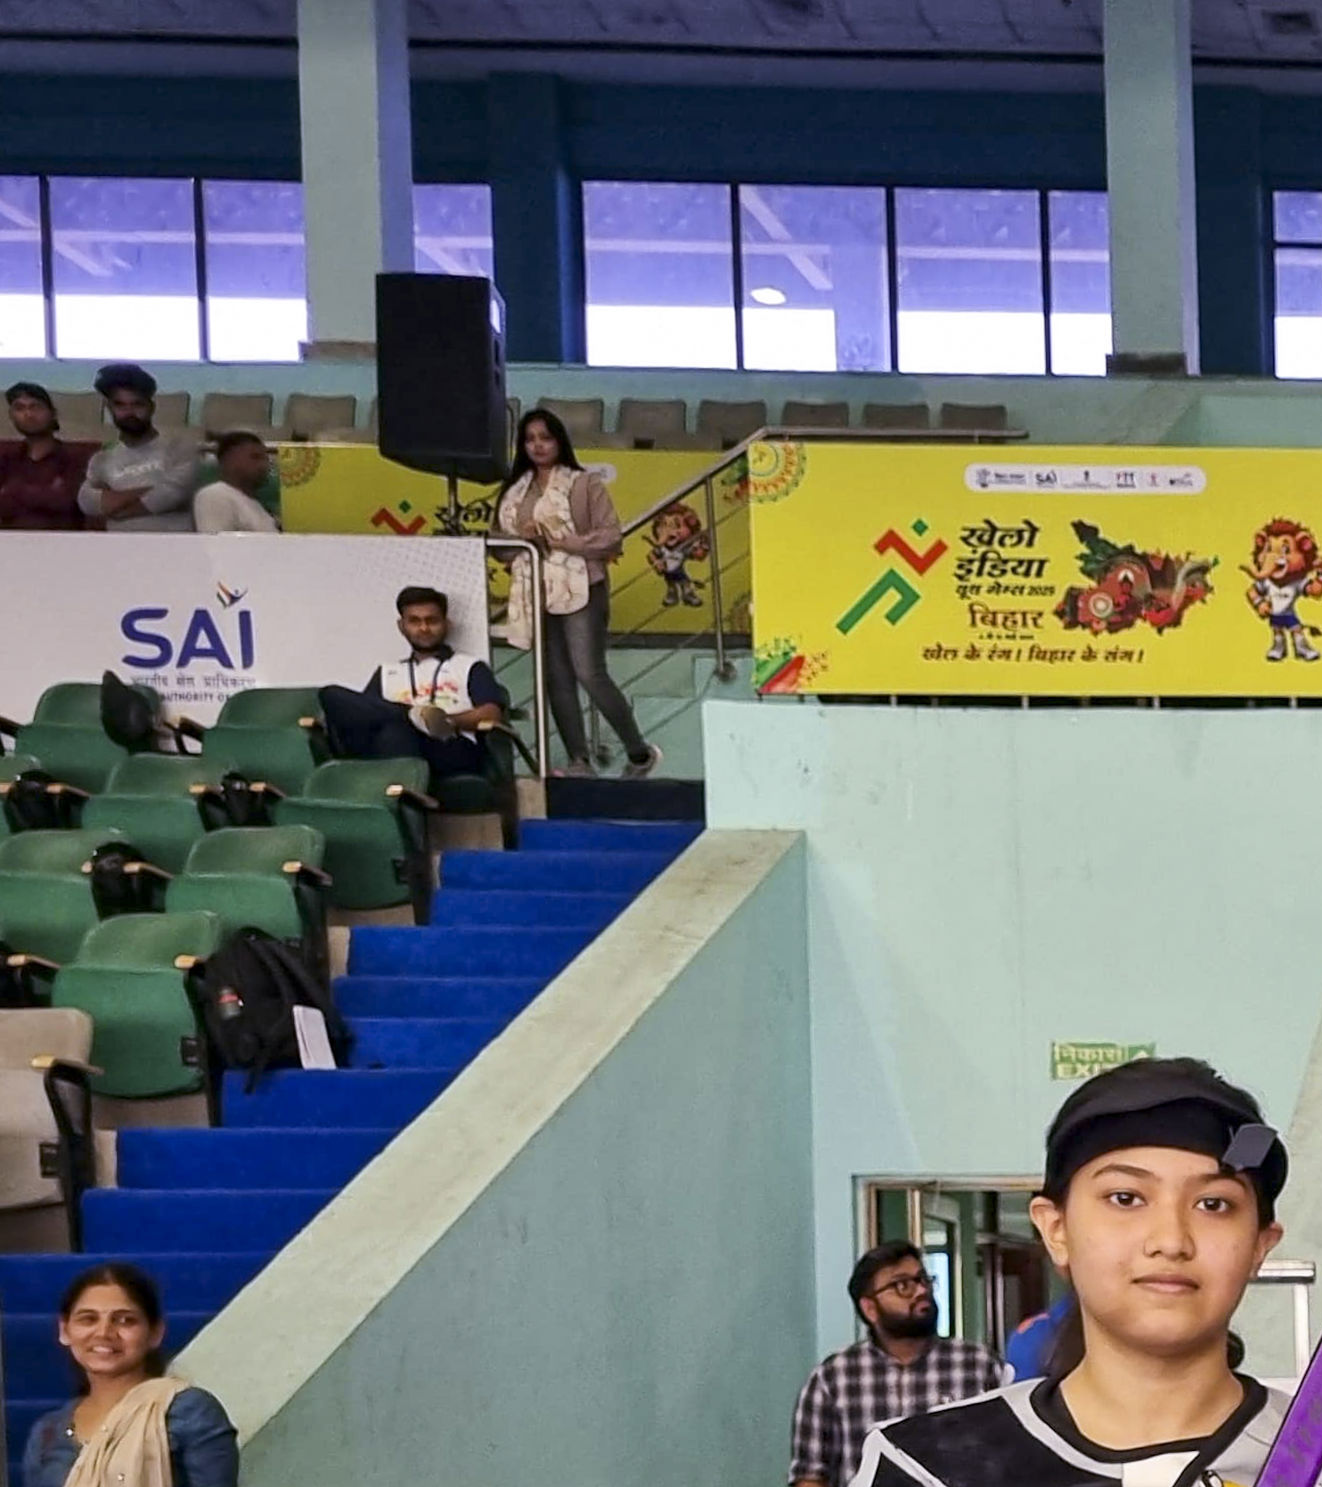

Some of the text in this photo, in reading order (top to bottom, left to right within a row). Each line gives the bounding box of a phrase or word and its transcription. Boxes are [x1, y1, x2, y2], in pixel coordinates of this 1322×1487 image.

[959, 518, 1041, 548] खेलो
[953, 549, 1051, 583] इंडिया
[968, 601, 1045, 631] बिहार
[120, 608, 254, 670] SAI
[922, 642, 959, 661] खेल
[963, 643, 982, 661] के
[1027, 643, 1077, 664] बिहार
[1080, 643, 1098, 661] के
